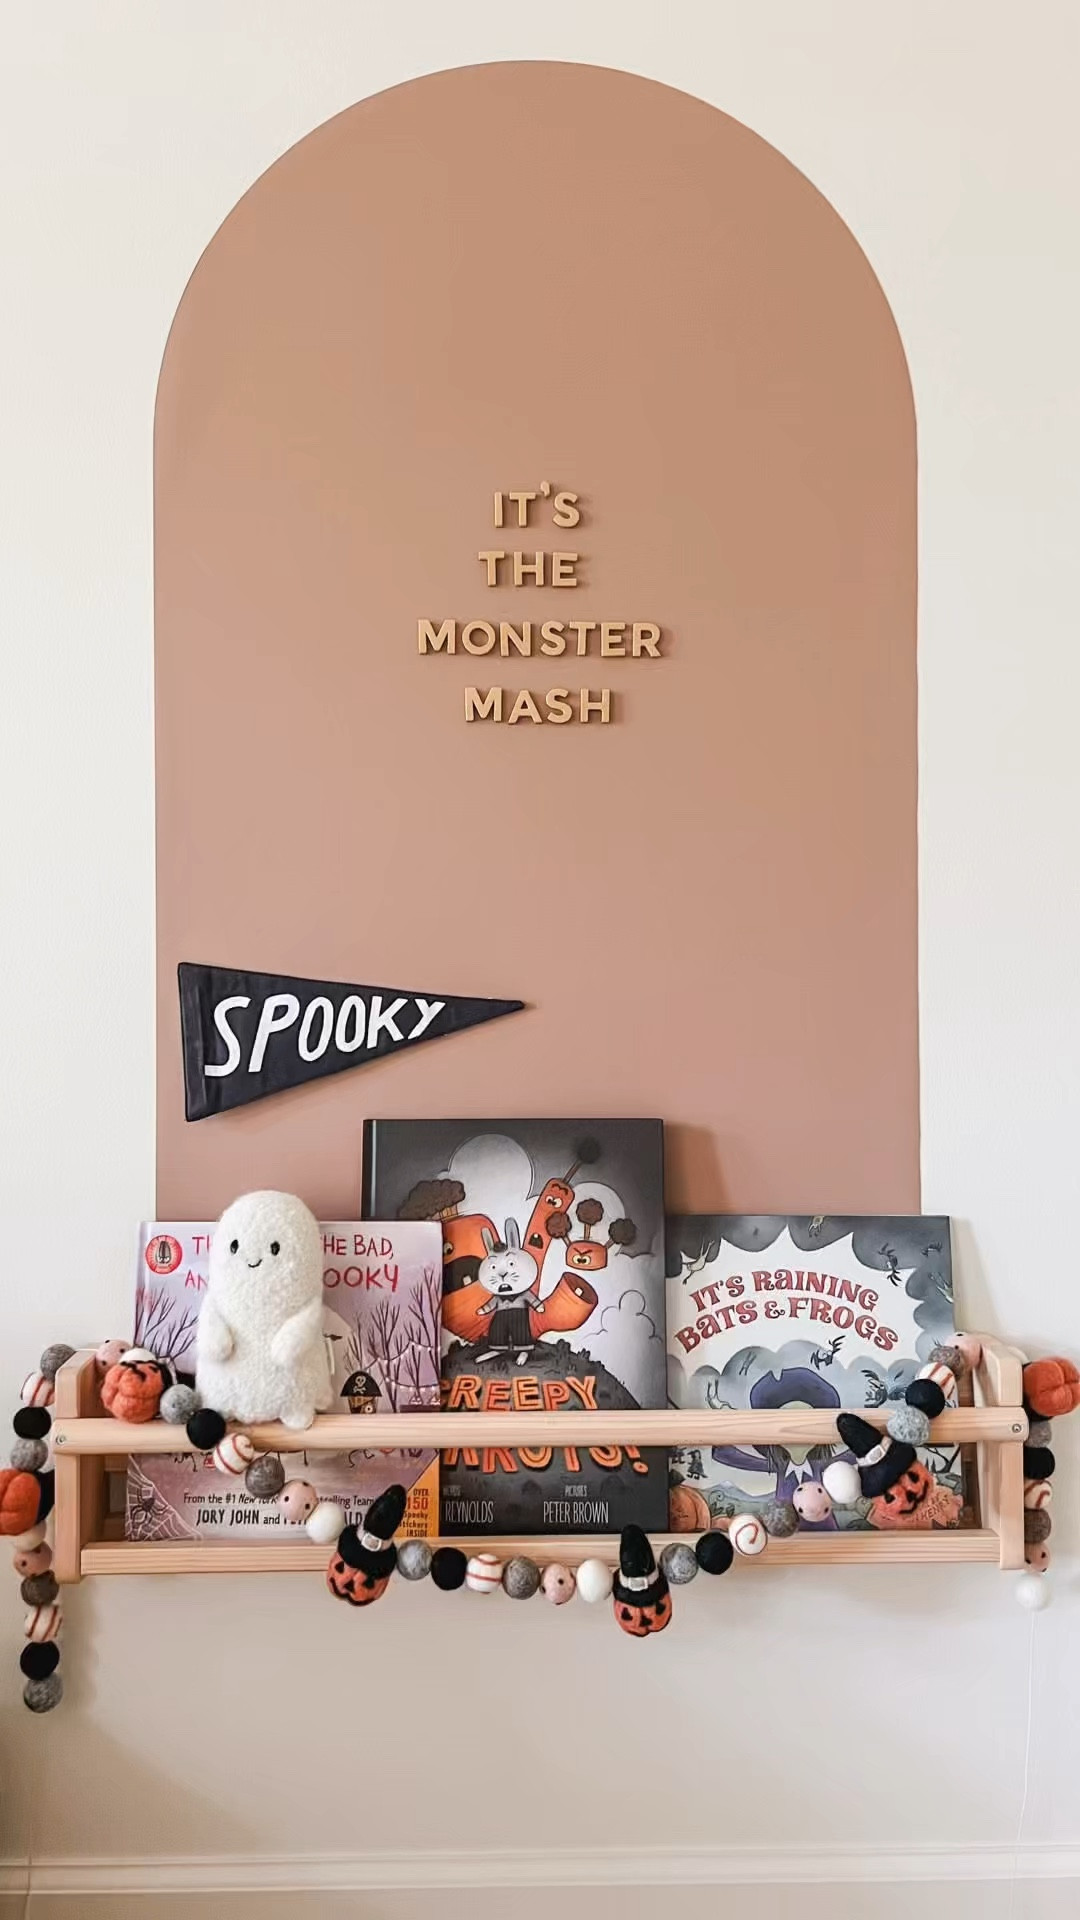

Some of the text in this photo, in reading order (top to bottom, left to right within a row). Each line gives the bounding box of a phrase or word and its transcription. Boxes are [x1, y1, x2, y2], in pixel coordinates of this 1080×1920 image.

[494, 480, 580, 528] IT'S
[478, 550, 578, 588] THE
[417, 618, 661, 657] MONSTER
[464, 686, 611, 724] MASH
[204, 993, 446, 1077] SPOOKY
[322, 1234, 394, 1260] HE BAD,
[184, 1263, 399, 1292] AN OOKY
[690, 1275, 745, 1312] IT'S
[764, 1300, 785, 1320] &
[788, 1297, 899, 1352] FROGS
[440, 1375, 598, 1411] REEPY
[183, 1492, 206, 1504] From
[208, 1493, 223, 1504] the
[226, 1493, 236, 1504] #1
[238, 1493, 257, 1504] New
[413, 1488, 429, 1497] OVER
[196, 1508, 225, 1526] JORY
[229, 1508, 260, 1526] JOHN
[263, 1513, 280, 1525] and
[400, 1521, 428, 1529] tickers
[445, 1500, 494, 1523] REYNOLDS
[543, 1501, 609, 1524] PETER BROWN
